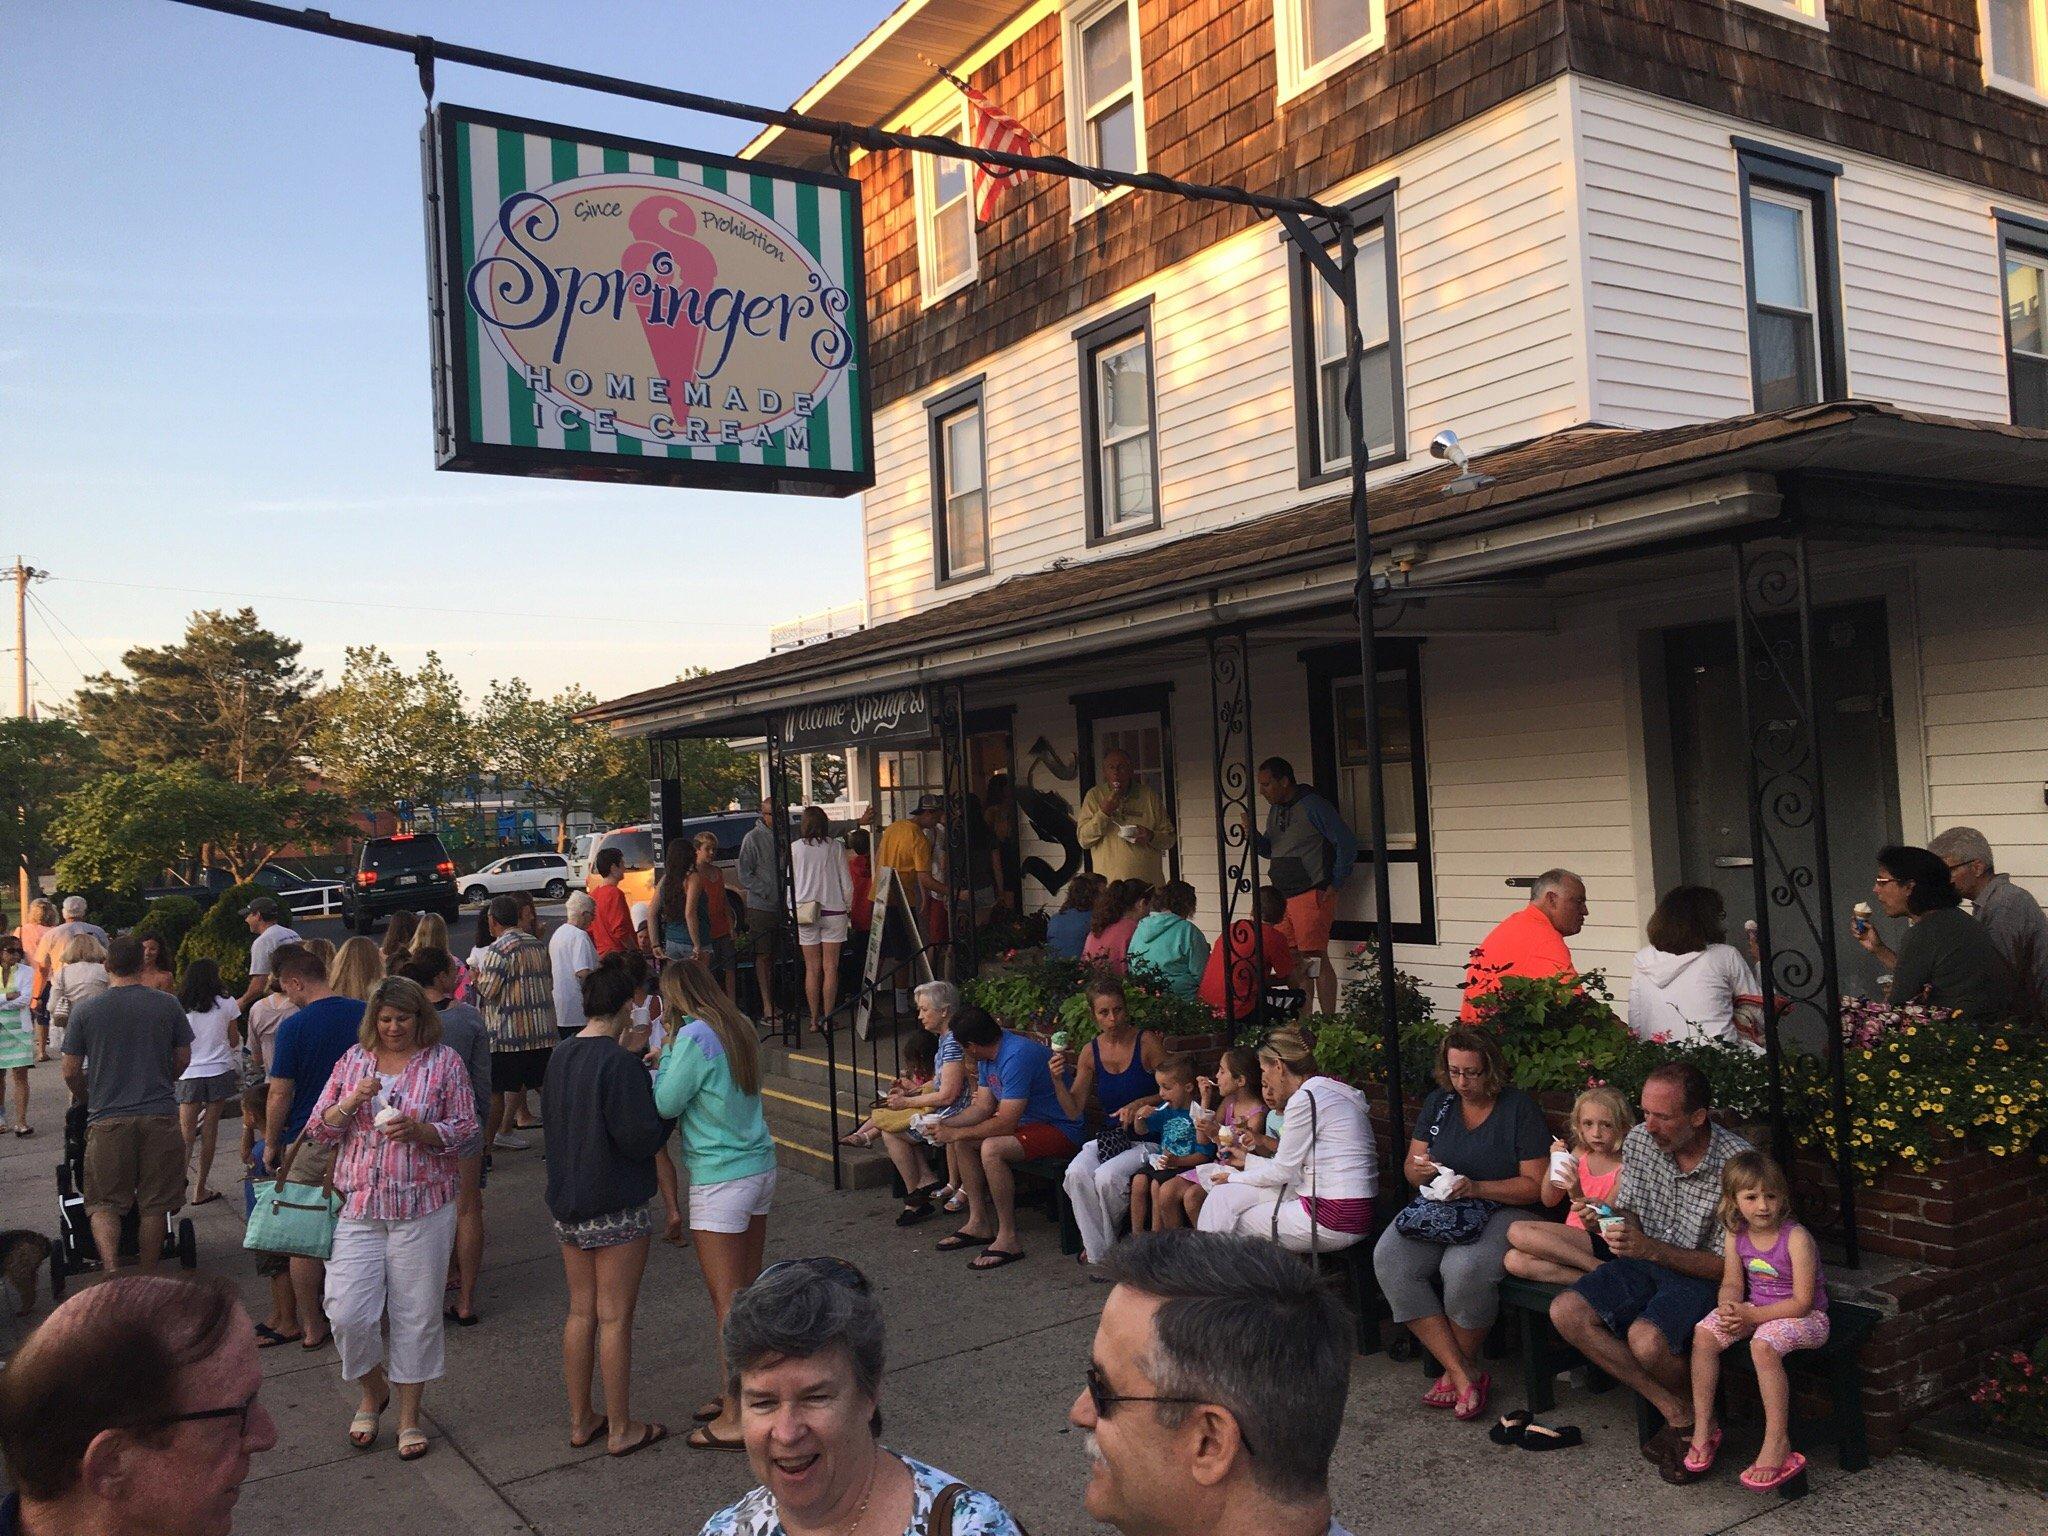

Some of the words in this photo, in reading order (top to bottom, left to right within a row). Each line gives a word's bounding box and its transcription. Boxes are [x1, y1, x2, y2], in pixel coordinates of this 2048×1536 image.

[574, 200, 623, 222] Since
[701, 211, 785, 262] Prohibition
[466, 192, 853, 379] Springer's
[524, 364, 814, 417] HOMEMADE
[532, 402, 618, 434] ICE
[649, 413, 810, 450] CREAM
